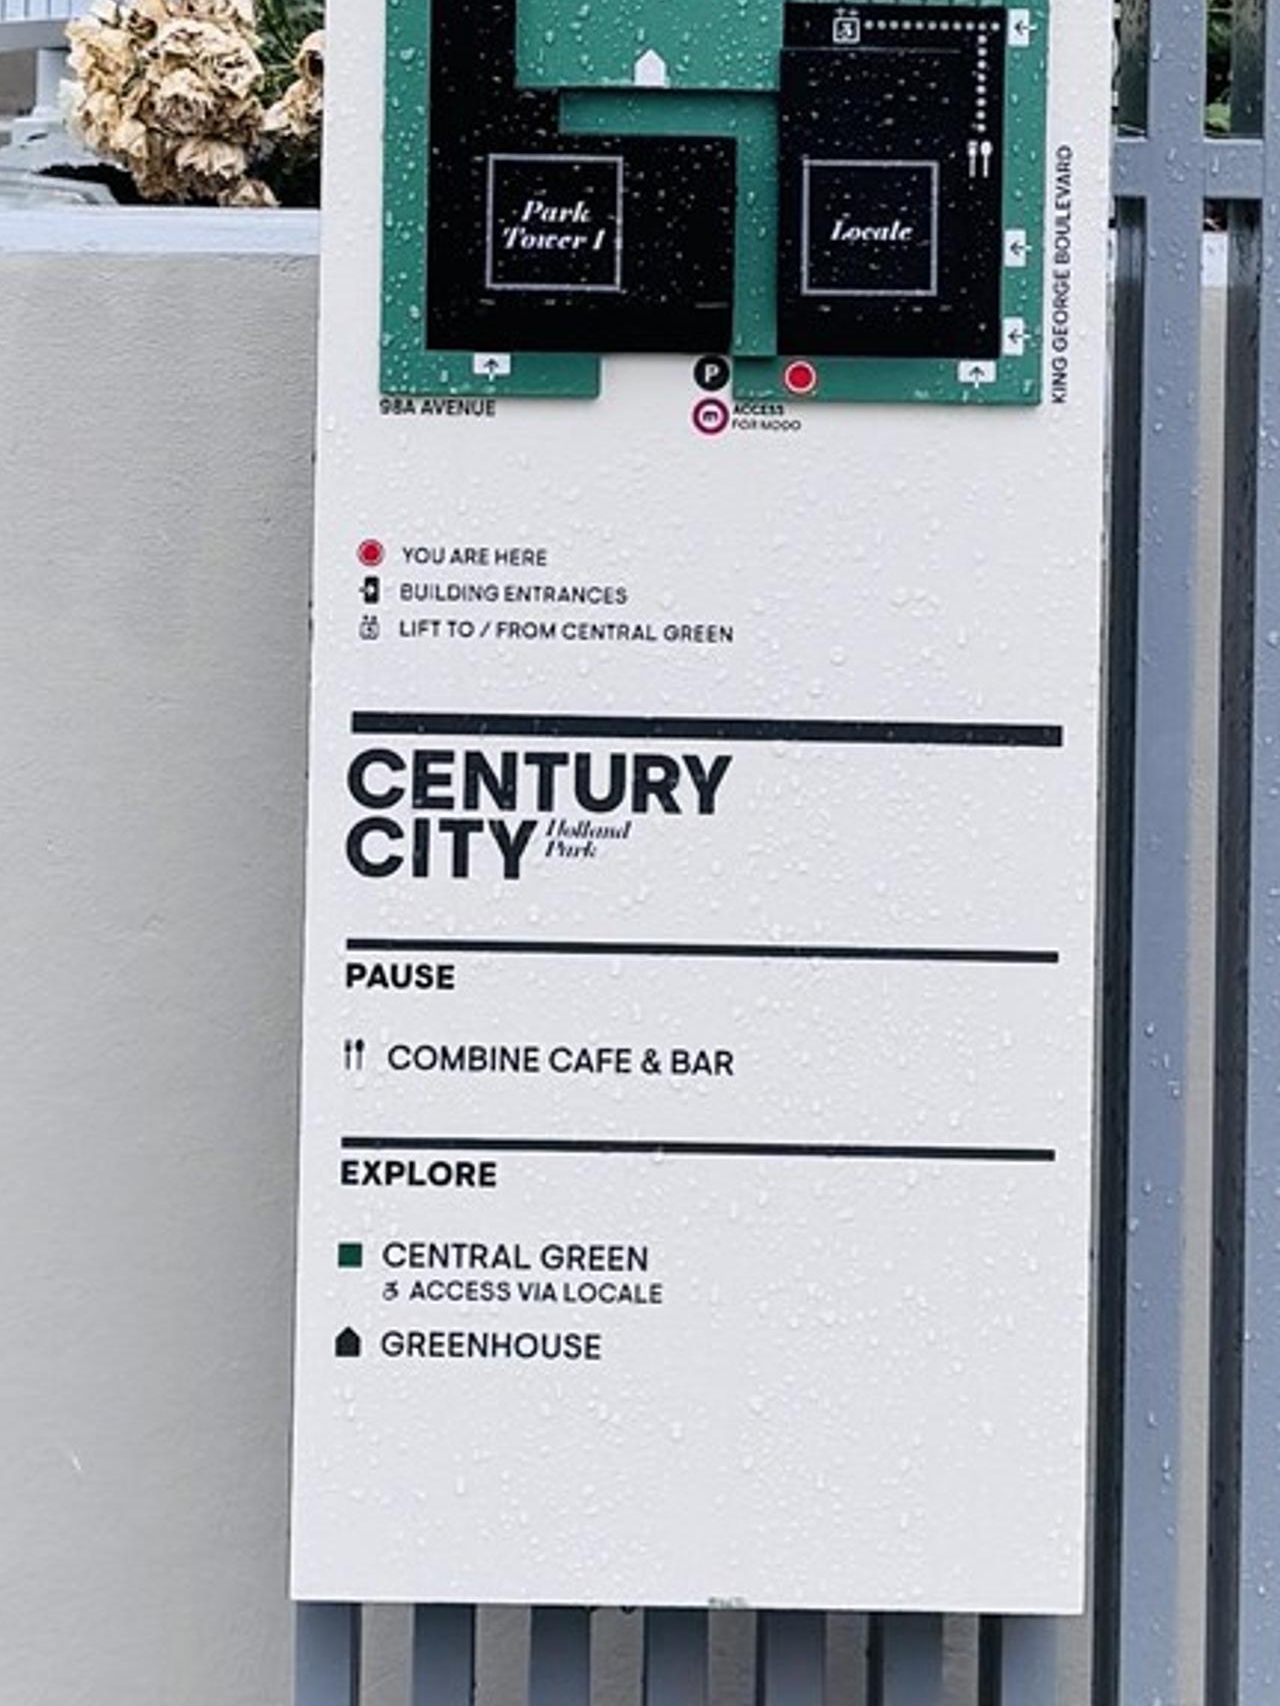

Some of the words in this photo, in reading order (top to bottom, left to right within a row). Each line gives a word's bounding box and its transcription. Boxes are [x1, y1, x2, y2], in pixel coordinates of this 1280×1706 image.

[520, 199, 592, 224] Park
[1054, 144, 1074, 265] BOULEVARD
[501, 226, 589, 250] Tower
[591, 227, 607, 251] 1
[830, 218, 914, 241] Locale
[1052, 269, 1071, 353] GEORGE
[1051, 356, 1069, 405] KING
[379, 398, 417, 416] 98A
[420, 398, 497, 417] AVENUE
[401, 546, 446, 565] YOU
[449, 547, 490, 565] ARE
[494, 547, 548, 567] HERE
[399, 582, 500, 603] BUILDING
[503, 585, 629, 606] ENTRANCES
[399, 619, 441, 639] LIFT
[447, 619, 476, 639] TO
[478, 620, 491, 639] /
[495, 620, 557, 640] FROM
[561, 622, 658, 643] CENTRAL
[663, 624, 734, 644] GREEN
[346, 747, 733, 816] CENTURY
[545, 817, 633, 840] Holland
[345, 816, 538, 881] CITY
[545, 840, 598, 858] Park
[344, 964, 456, 991] PAUSE
[387, 1042, 541, 1074] COMBINE
[548, 1045, 633, 1075] CAFE
[641, 1047, 664, 1076] &
[670, 1048, 736, 1077] BAR
[340, 1160, 498, 1188] EXPLORE
[381, 1242, 532, 1271] CENTRAL
[539, 1244, 650, 1273] GREEN
[408, 1279, 512, 1303] ACCESS
[517, 1281, 558, 1303] VIA
[563, 1282, 664, 1305] LOCALE
[380, 1330, 603, 1360] GREENHOUSE
